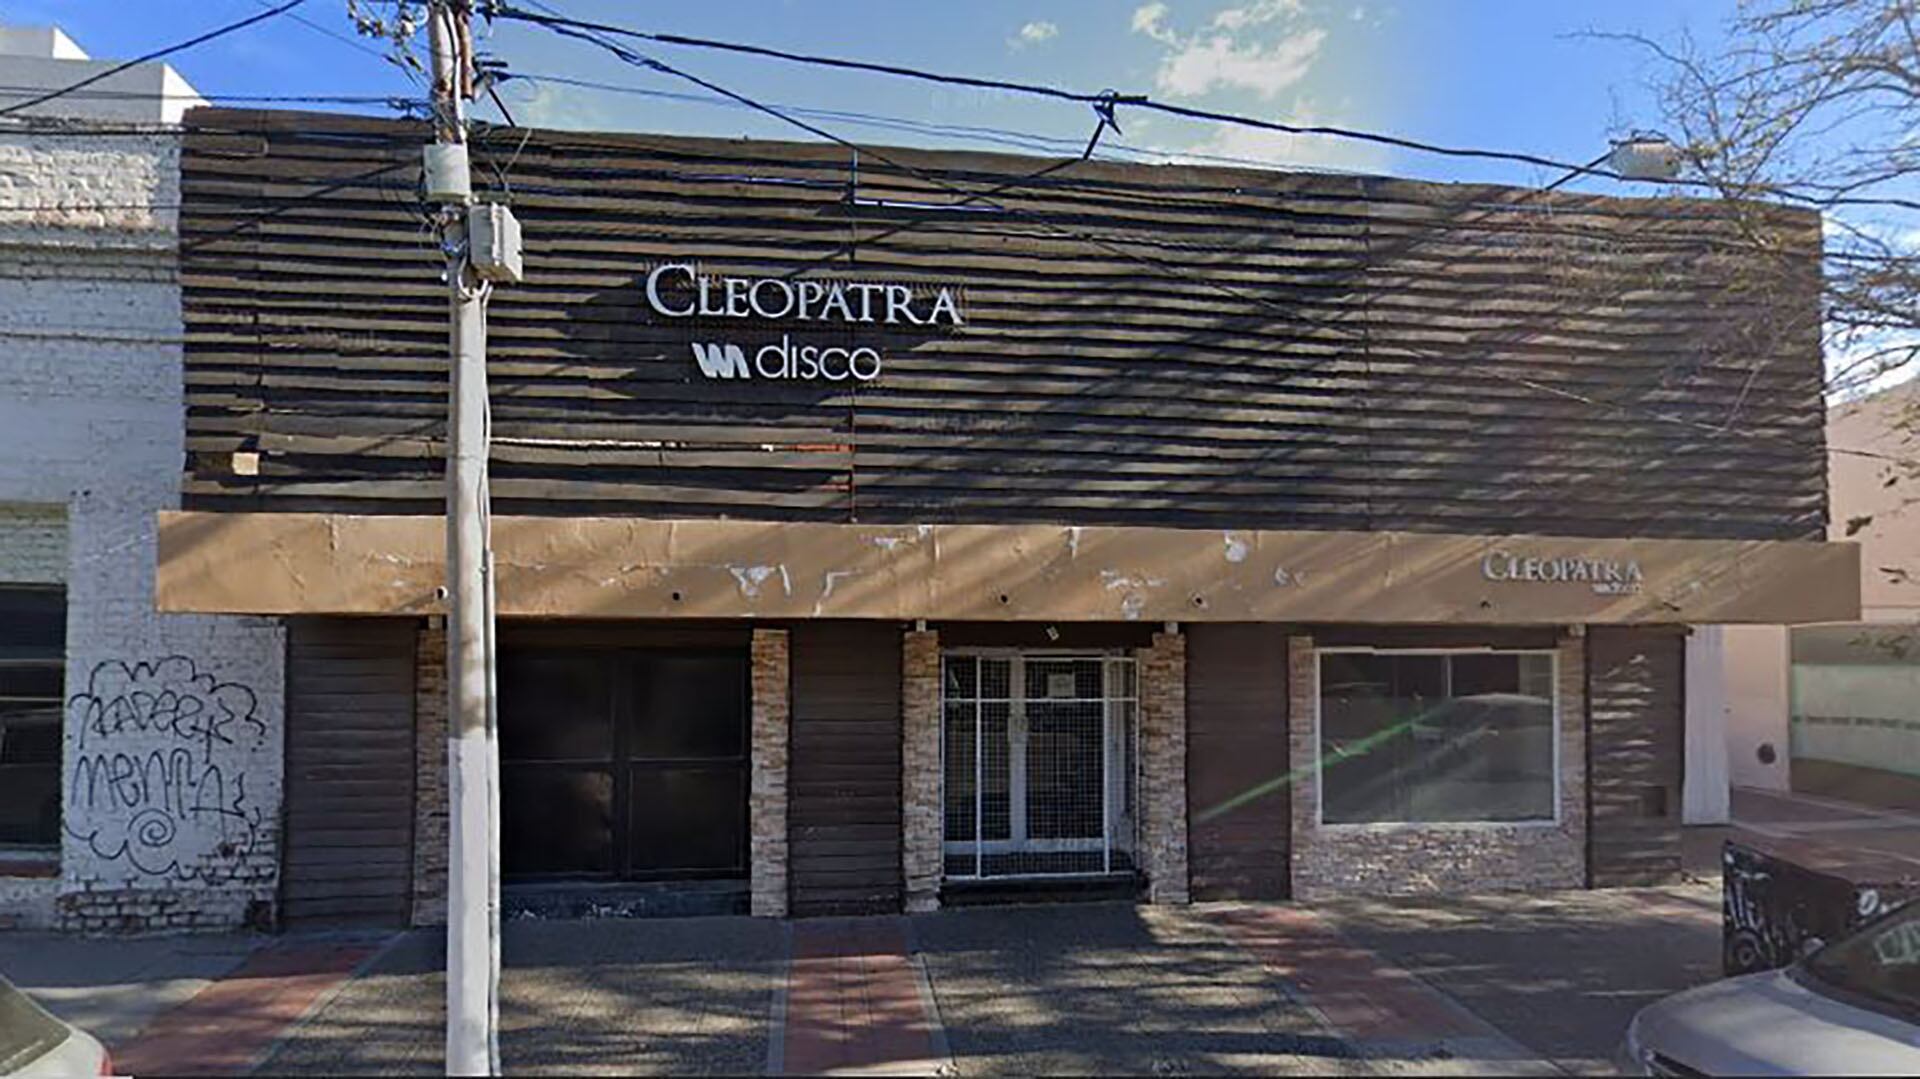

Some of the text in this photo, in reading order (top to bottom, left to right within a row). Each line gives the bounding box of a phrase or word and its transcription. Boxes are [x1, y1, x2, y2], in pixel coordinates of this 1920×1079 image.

[645, 263, 965, 326] CLEOPATRA
[756, 334, 881, 381] disco
[1483, 550, 1643, 582] CLEOPATRA
